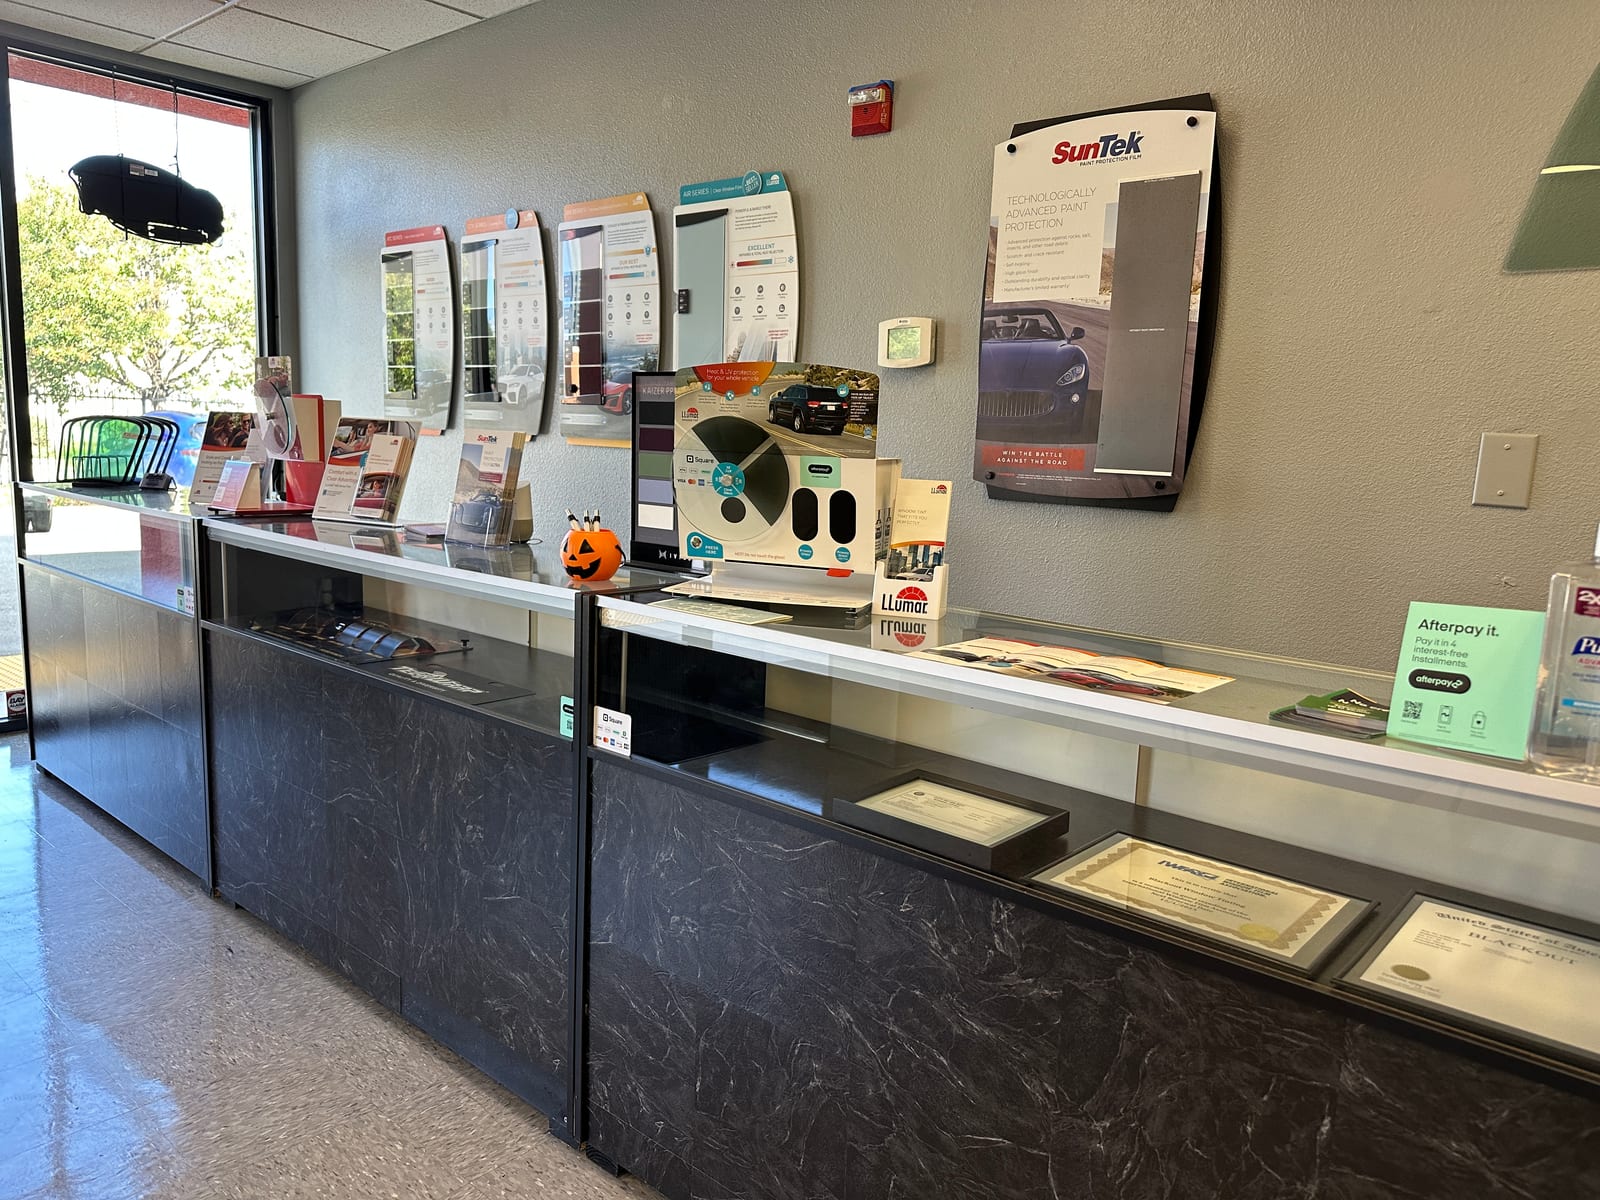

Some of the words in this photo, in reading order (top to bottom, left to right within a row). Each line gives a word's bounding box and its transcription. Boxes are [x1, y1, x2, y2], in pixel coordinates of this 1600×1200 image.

[1052, 131, 1144, 165] SunTek
[1096, 156, 1128, 164] PROTECTION
[692, 188, 710, 196] SERIES
[1007, 187, 1097, 206] TECHNOLOGICALLY
[1006, 205, 1057, 218] ADVANCED
[1060, 202, 1088, 213] PAINT
[1004, 218, 1064, 232] PROTECTION
[748, 243, 775, 252] EXCELLENT
[642, 386, 665, 395] KAIZER
[666, 386, 674, 394] PP
[881, 593, 928, 614] LLumar
[1418, 619, 1484, 637] Afterpay
[1486, 624, 1499, 637] it.
[1415, 636, 1433, 646] Pay
[1434, 638, 1440, 646] it
[1441, 638, 1449, 646] in
[1414, 646, 1468, 658] interest-free
[1412, 654, 1468, 668] Installments.
[1416, 675, 1453, 687] afterpay
[608, 716, 622, 725] Square
[1436, 912, 1486, 926] United
[1490, 924, 1540, 940] States
[1468, 932, 1578, 964] BLACKOUT
